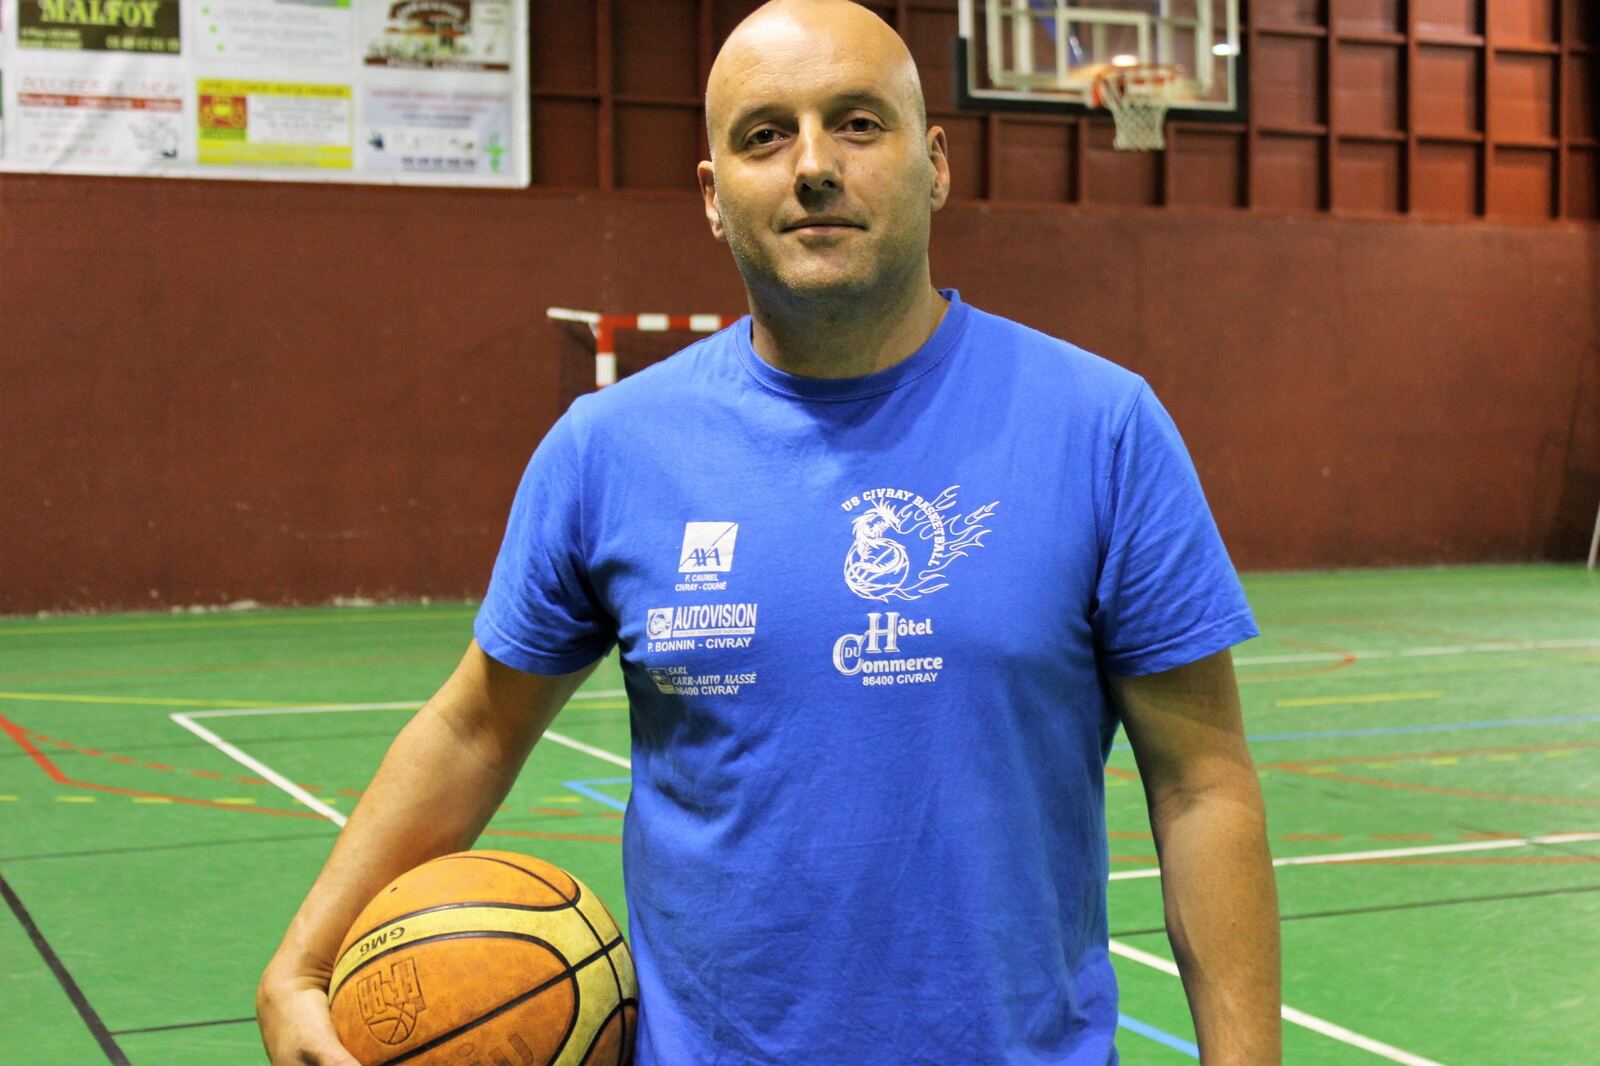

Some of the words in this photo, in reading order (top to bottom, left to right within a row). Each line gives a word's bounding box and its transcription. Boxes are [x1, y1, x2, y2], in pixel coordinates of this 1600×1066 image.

[40, 0, 159, 28] MALFOY
[841, 496, 861, 512] US
[862, 488, 914, 501] CIVRAY
[686, 547, 721, 567] AXA
[675, 583, 699, 592] CIVRAY
[673, 603, 758, 630] AUTOVISION
[865, 611, 934, 654] Hôtel
[655, 640, 695, 651] BONNIN
[705, 638, 752, 648] CIVRAY
[832, 633, 944, 676] Commerce
[862, 676, 894, 686] 86400
[896, 672, 939, 685] CIVRAY
[701, 685, 740, 696] CIVRAY
